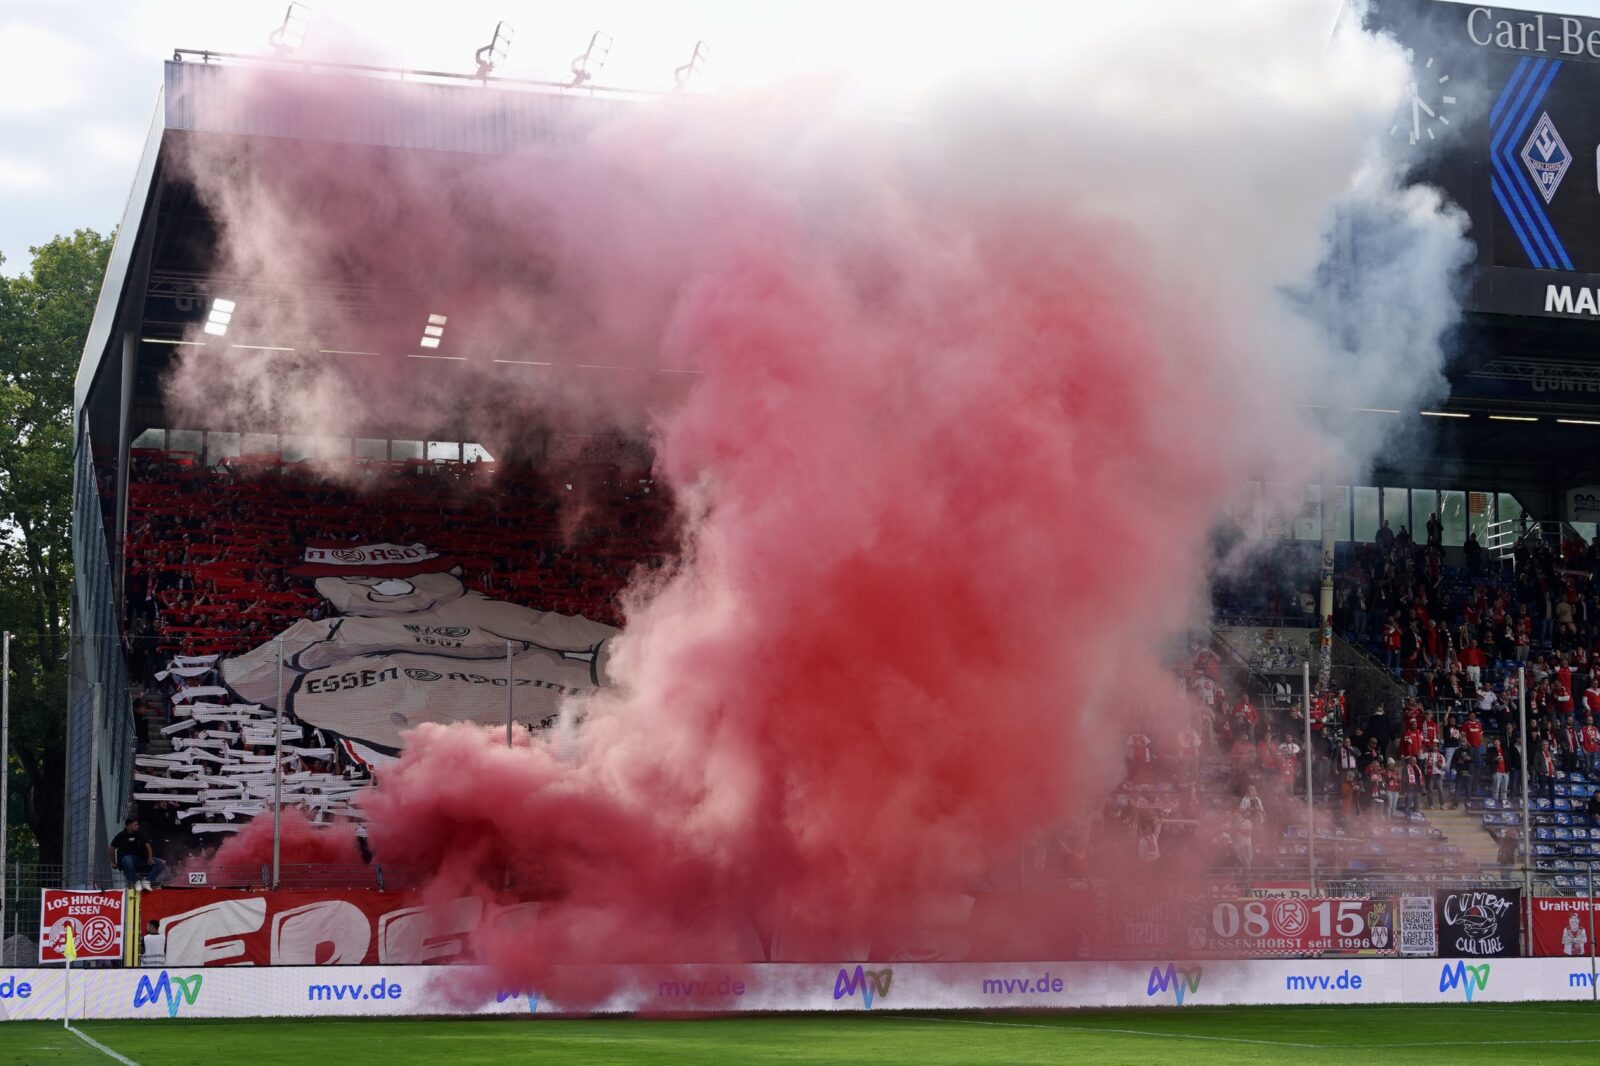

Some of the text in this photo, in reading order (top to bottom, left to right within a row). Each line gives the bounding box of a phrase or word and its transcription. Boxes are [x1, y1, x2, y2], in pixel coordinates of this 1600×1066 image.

[1542, 171, 1555, 184] 07
[1544, 284, 1600, 315] MA
[190, 873, 204, 882] 27
[46, 895, 121, 911] LOS HINCHAS
[68, 905, 101, 915] ESSEN
[1212, 902, 1270, 938] 08
[1311, 901, 1364, 937] 15
[1402, 911, 1434, 919] MISSING
[1307, 937, 1332, 949] seit
[1338, 938, 1370, 949] 1996
[1456, 937, 1505, 955] CULTURE
[982, 973, 1064, 994] mvv.de
[1286, 970, 1362, 990] mvv.de
[308, 978, 402, 1000] mvv.de
